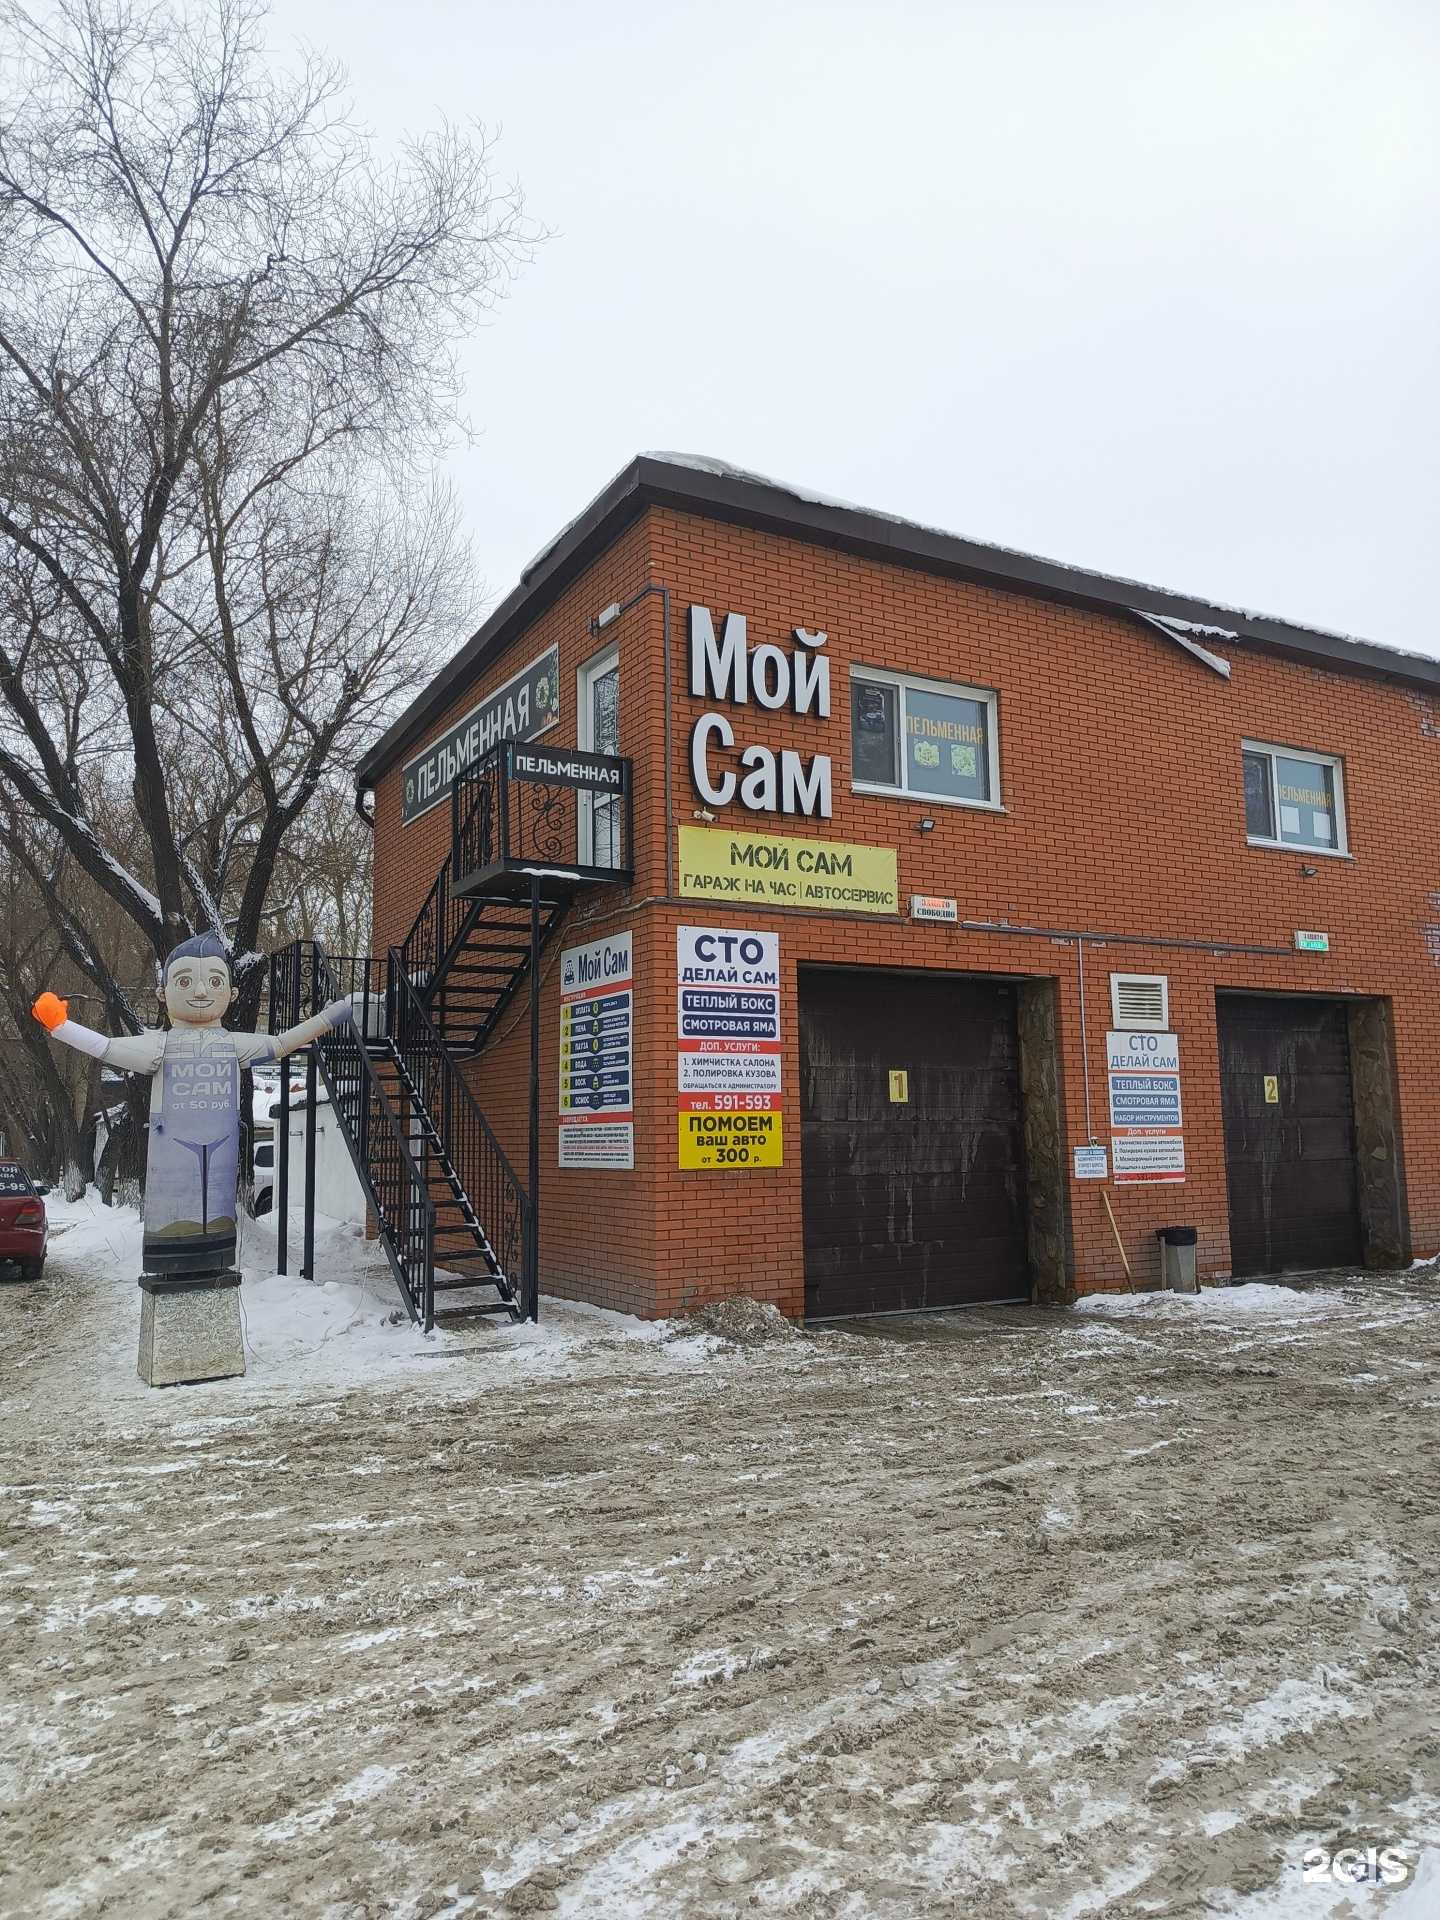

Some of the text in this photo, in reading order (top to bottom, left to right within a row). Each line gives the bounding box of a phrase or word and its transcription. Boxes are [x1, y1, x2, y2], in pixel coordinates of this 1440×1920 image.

[689, 604, 832, 718] Мой
[906, 715, 984, 745] ПЕЛЬМЕННАЯ
[417, 683, 530, 803] ПЕЛЬМЕННАЯ
[516, 754, 620, 784] ПЕЛЬМЕННАЯ
[692, 712, 833, 819] Сам
[729, 841, 853, 877] МОЙ САМ
[683, 873, 894, 905] ГАРАЖ НА ЧАС АВТОСЕРВИС
[694, 934, 764, 965] СТО
[578, 946, 629, 983] Мой Сам
[682, 967, 776, 985] ДЕЛАЙ САМ
[685, 993, 773, 1011] ТЕПЛЫЙ БОКС
[683, 1018, 776, 1033] СМОТРОВАЯ ЯМА
[699, 1041, 761, 1052] ДОП. УСЛУГИ:
[1128, 1035, 1158, 1052] СТО
[171, 1060, 232, 1078] МОЙ
[683, 1057, 775, 1067] 1. ХИМЧИСТКА САЛОНА
[1111, 1053, 1177, 1068] ДЕЛАЙ САМ
[683, 1069, 777, 1078] 2. ПОЛИРОВКА КУЗОВА
[171, 1081, 232, 1096] САМ
[893, 1071, 903, 1098] 1
[1115, 1078, 1174, 1090] ТЕПЛЫЙ БОКС
[1266, 1078, 1277, 1101] 2
[172, 1099, 232, 1113] от 50 руб.
[690, 1094, 771, 1110] тел. 591-593
[1116, 1095, 1176, 1106] СМОТРОВАЯ ЯМА
[689, 1116, 773, 1132] ПОМОЕМ
[1127, 1128, 1143, 1137] Доп.
[696, 1135, 767, 1146] ваш авто
[701, 1148, 762, 1165] от 300 р.
